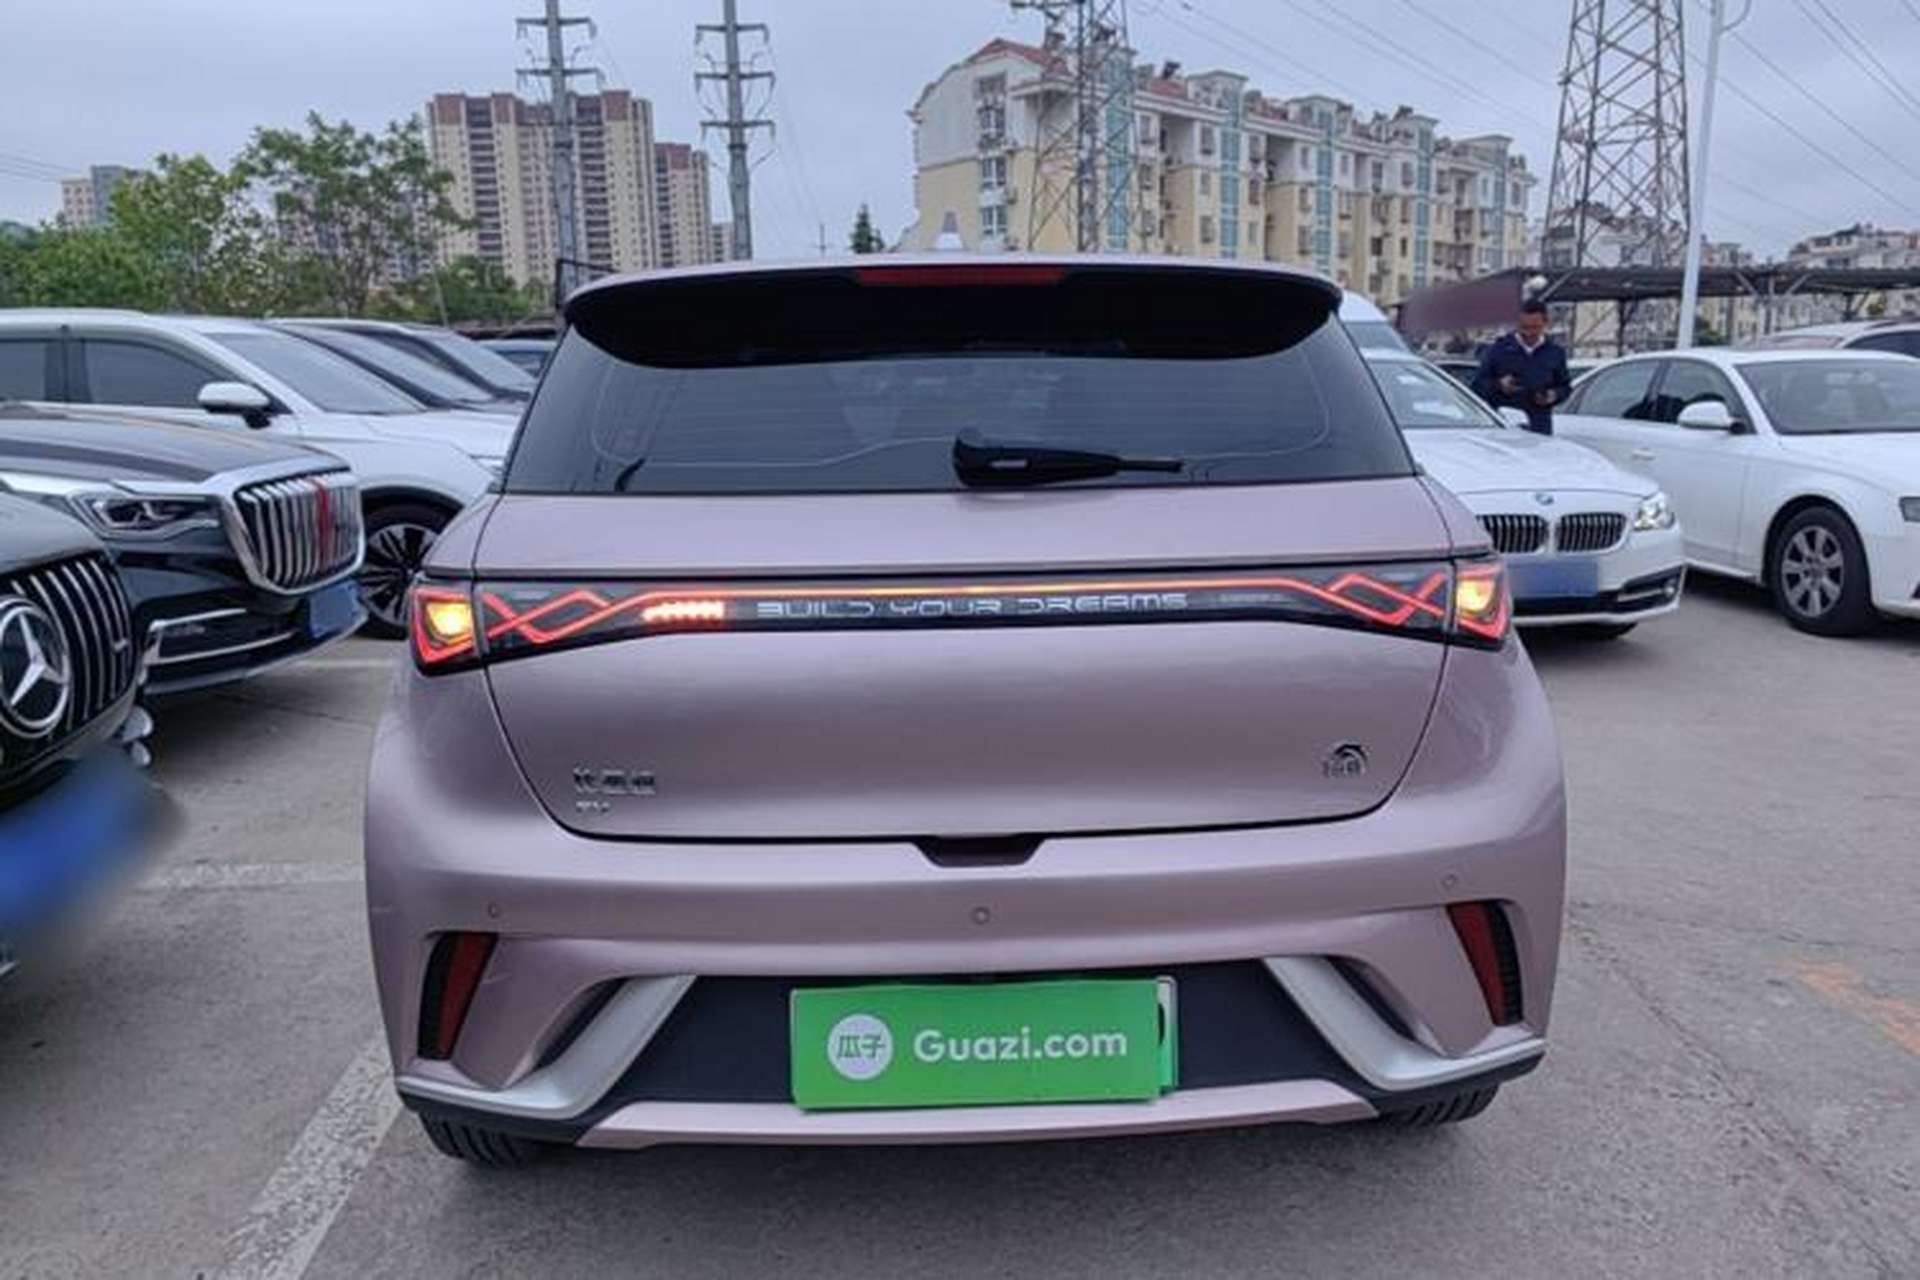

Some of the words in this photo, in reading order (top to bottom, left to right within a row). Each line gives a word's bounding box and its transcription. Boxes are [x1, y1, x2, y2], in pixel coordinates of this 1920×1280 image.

[757, 601, 874, 618] BUILD
[889, 599, 1002, 616] YOUR
[1017, 593, 1189, 615] DREAMS
[837, 1034, 886, 1059] 瓜子
[913, 1026, 1128, 1063] Guazi.com
